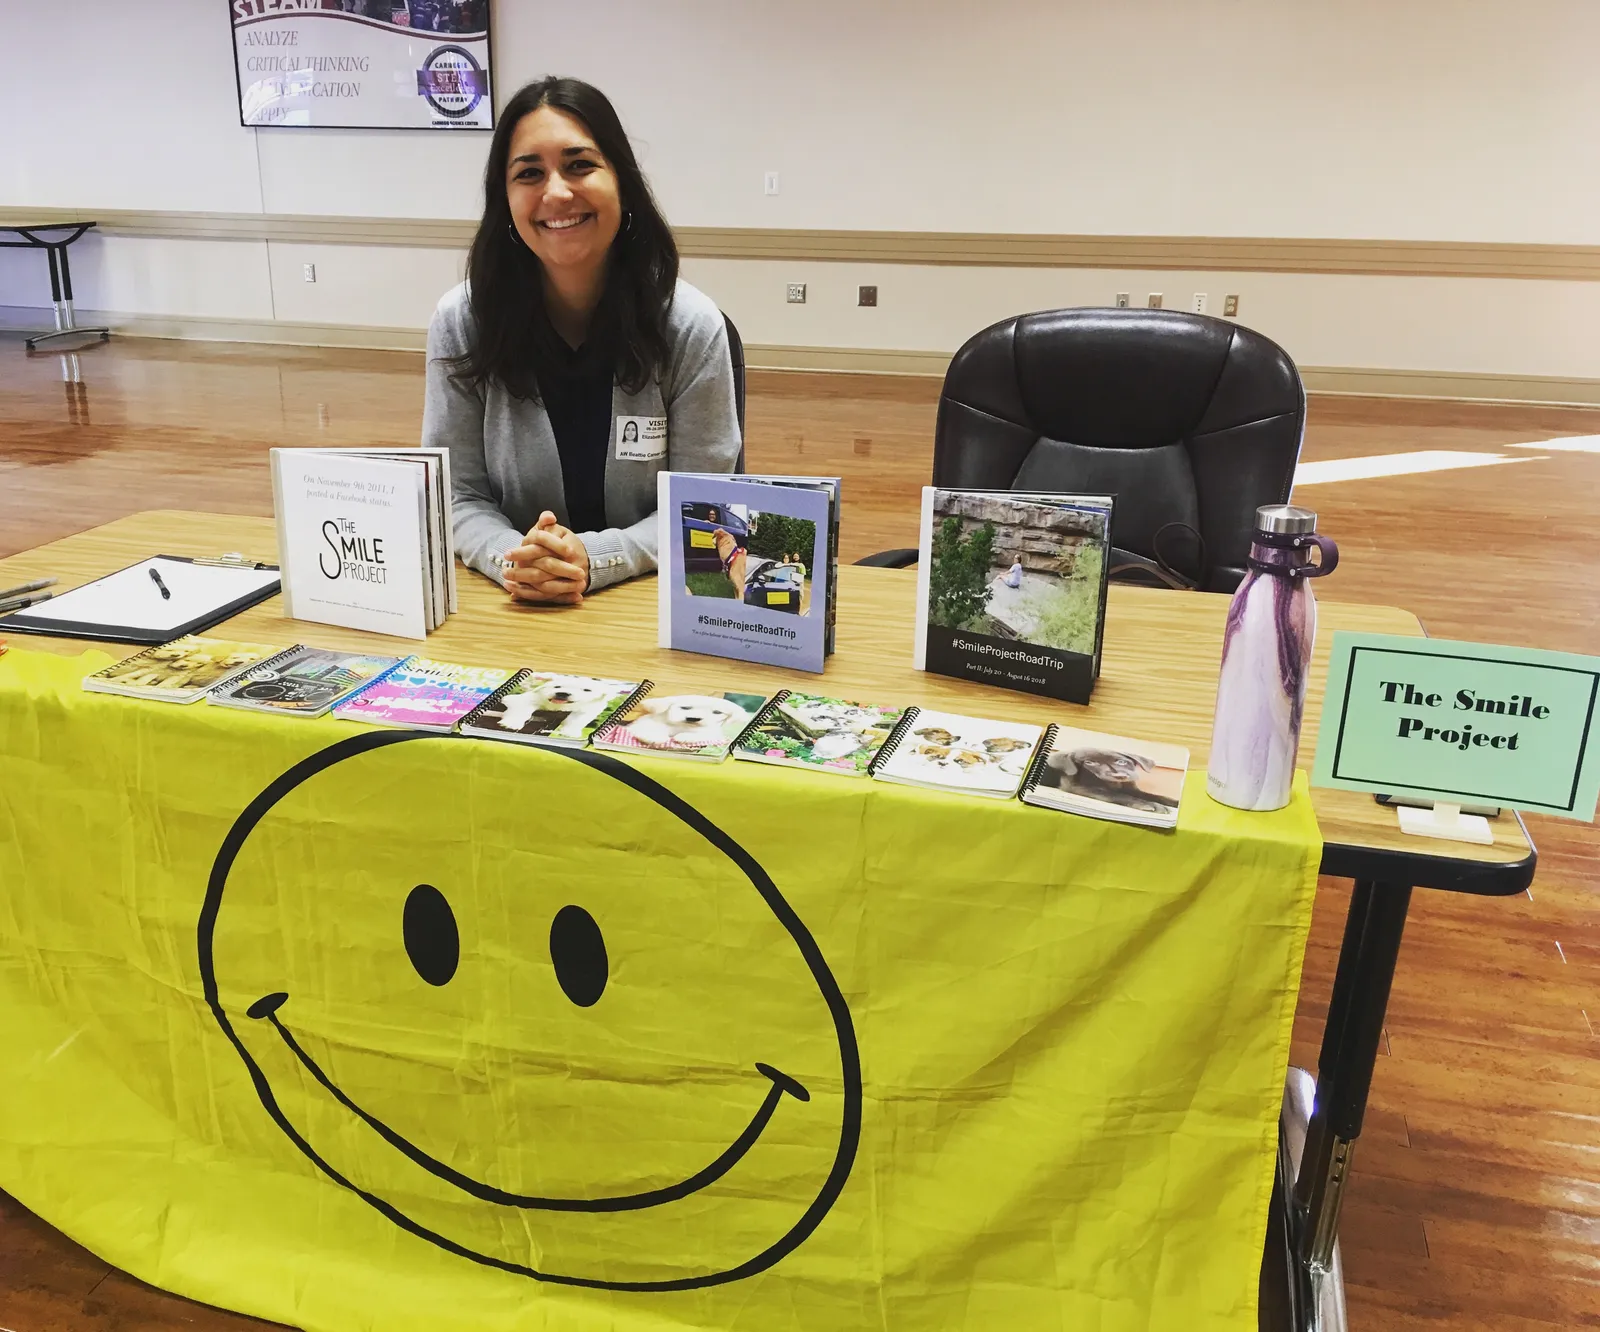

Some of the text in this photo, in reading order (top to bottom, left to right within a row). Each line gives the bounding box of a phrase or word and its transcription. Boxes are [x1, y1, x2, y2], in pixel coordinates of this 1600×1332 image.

[244, 30, 299, 46] ANALYZE
[247, 56, 369, 72] CRITICAL THINKING
[303, 474, 315, 484] On
[317, 476, 351, 489] November
[353, 481, 365, 491] 9th
[306, 489, 329, 499] posted
[336, 491, 367, 504] Facebook
[337, 517, 356, 534] THE
[319, 520, 385, 580] SMILE
[342, 561, 387, 585] PROJECT
[698, 615, 796, 640] #SmileProjectRoadTrip
[952, 639, 1063, 670] #SmileProjectRoadTrip
[966, 662, 977, 671] Part
[983, 666, 993, 676] July
[1006, 671, 1023, 681] August
[1031, 677, 1047, 685] 2018
[1379, 681, 1551, 720] The Smile
[1396, 716, 1520, 751] Project
